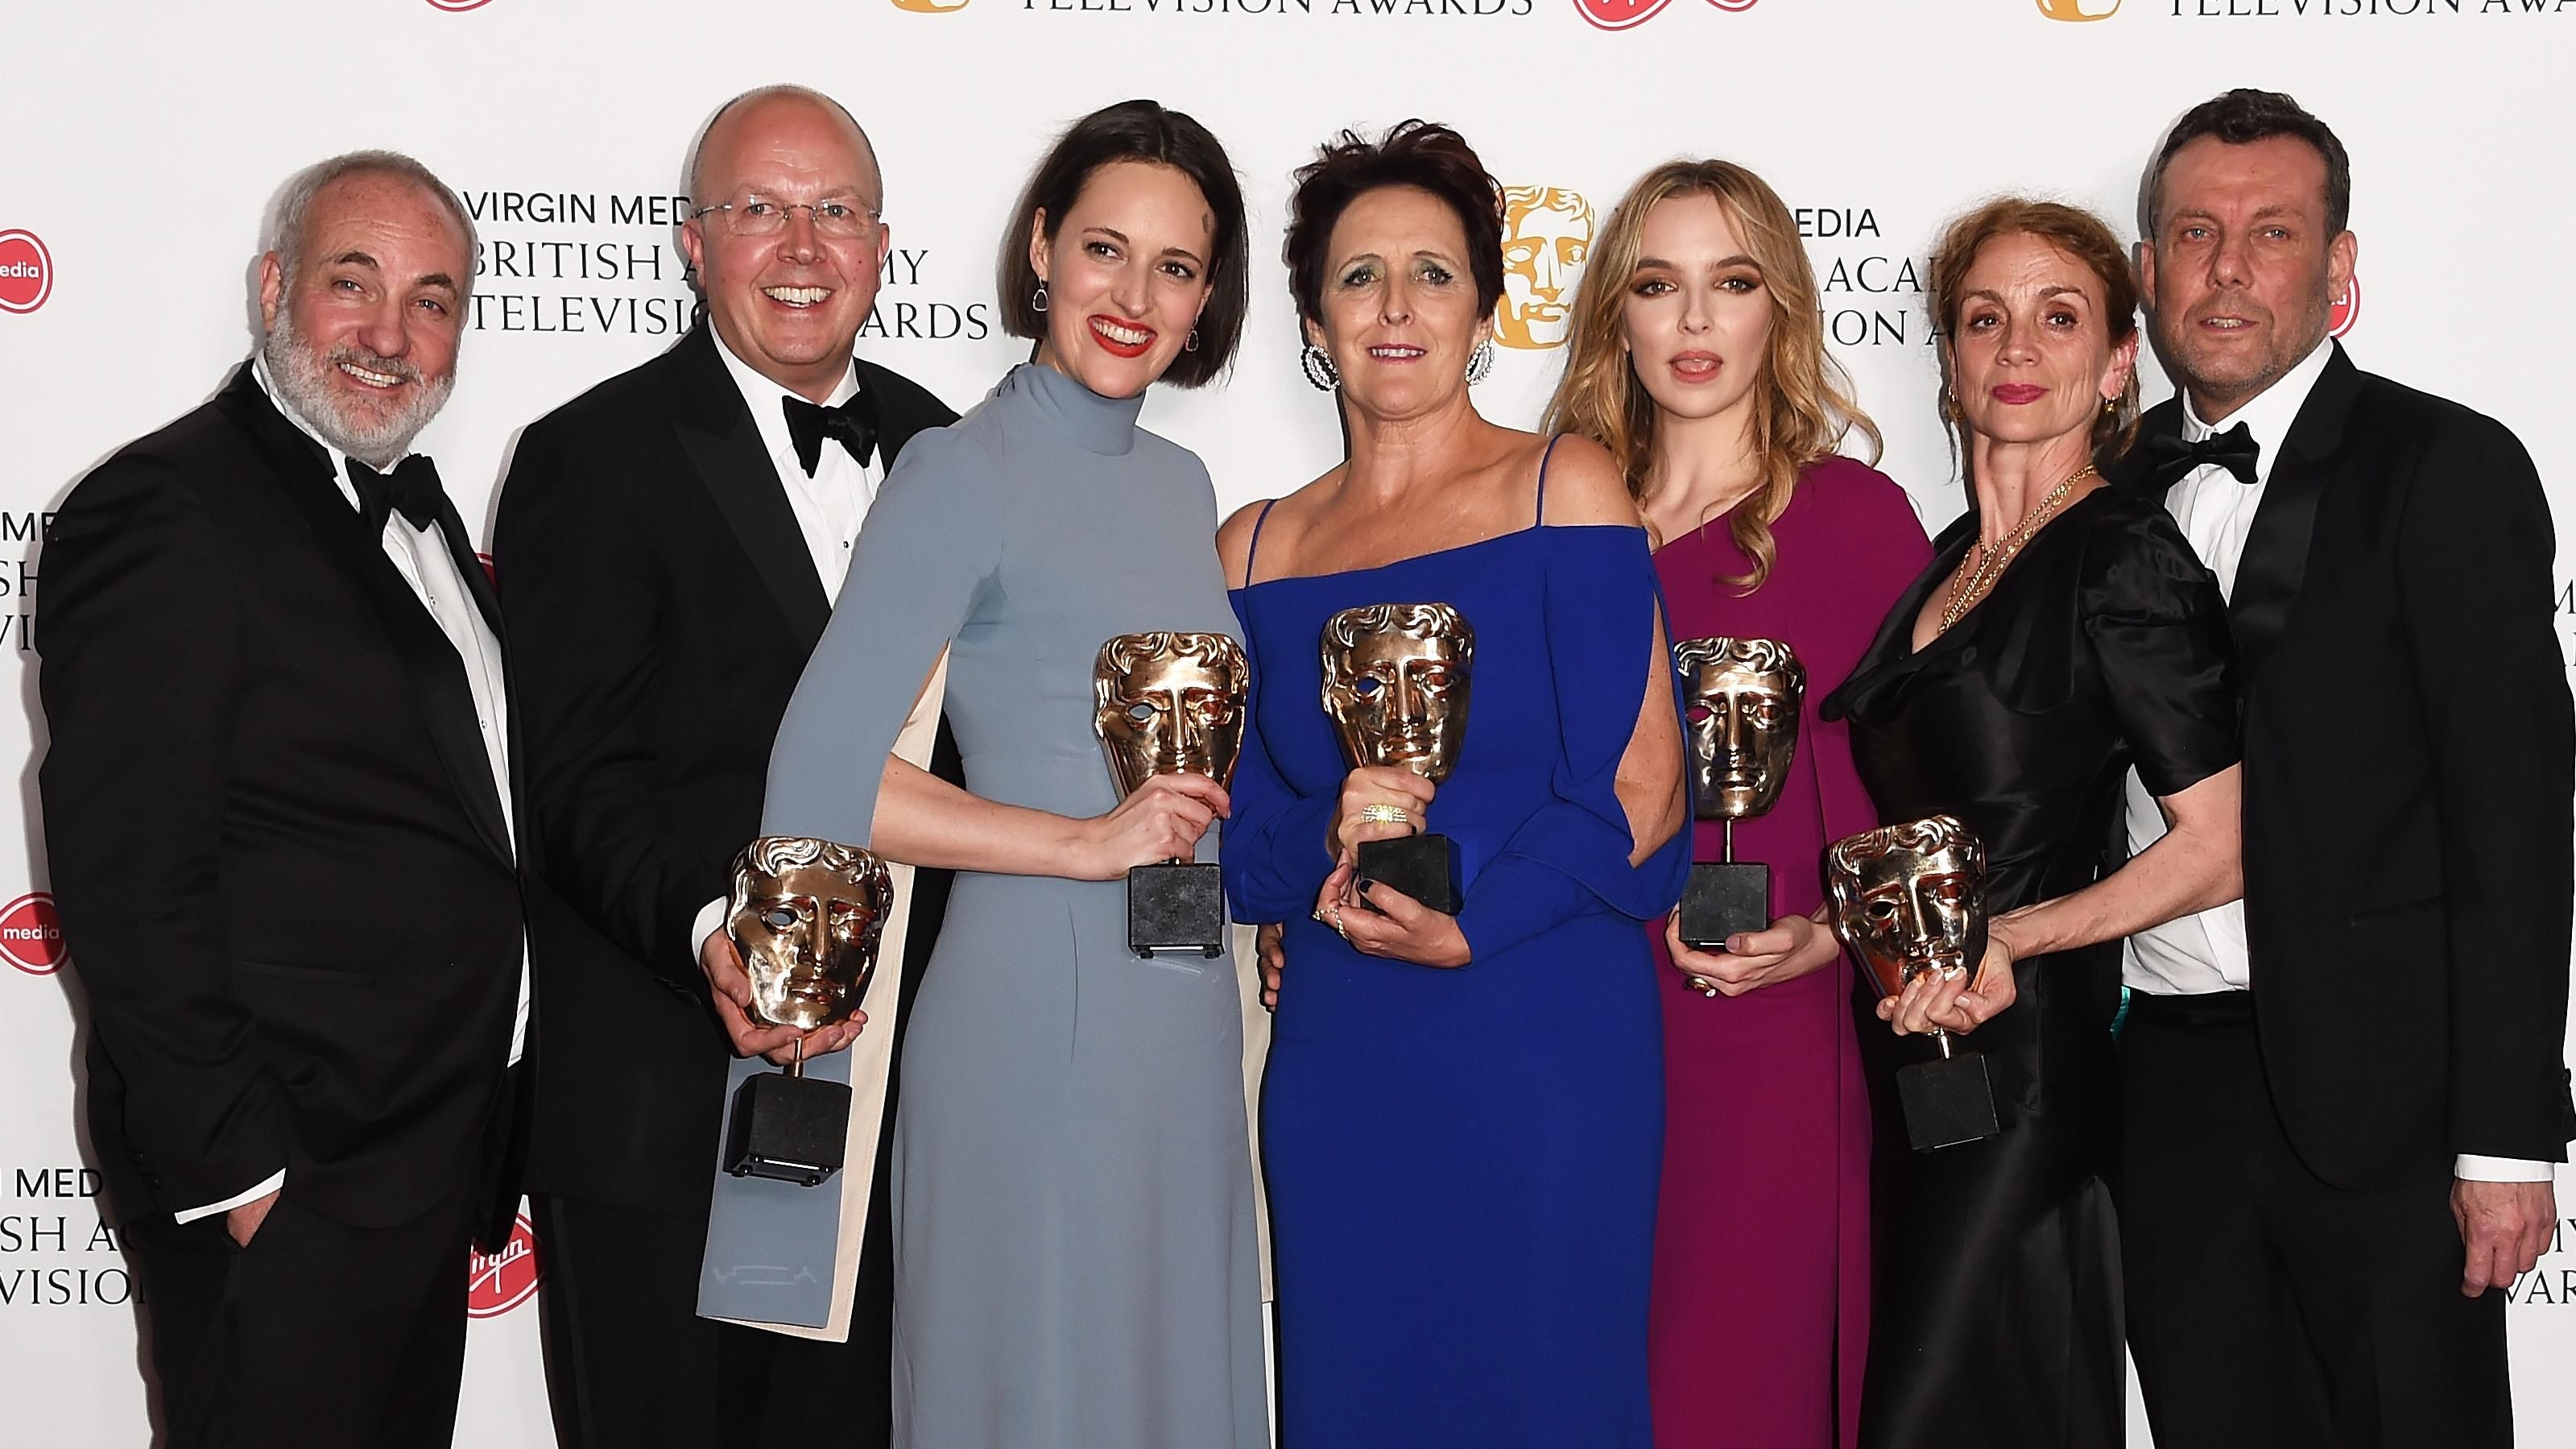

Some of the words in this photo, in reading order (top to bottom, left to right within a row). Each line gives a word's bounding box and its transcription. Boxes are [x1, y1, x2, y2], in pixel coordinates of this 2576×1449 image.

[463, 191, 595, 223] VIRGIN
[1795, 209, 1881, 238] EDIA
[2, 924, 60, 941] media
[16, 1168, 105, 1199] MED
[0, 1215, 67, 1252] SH
